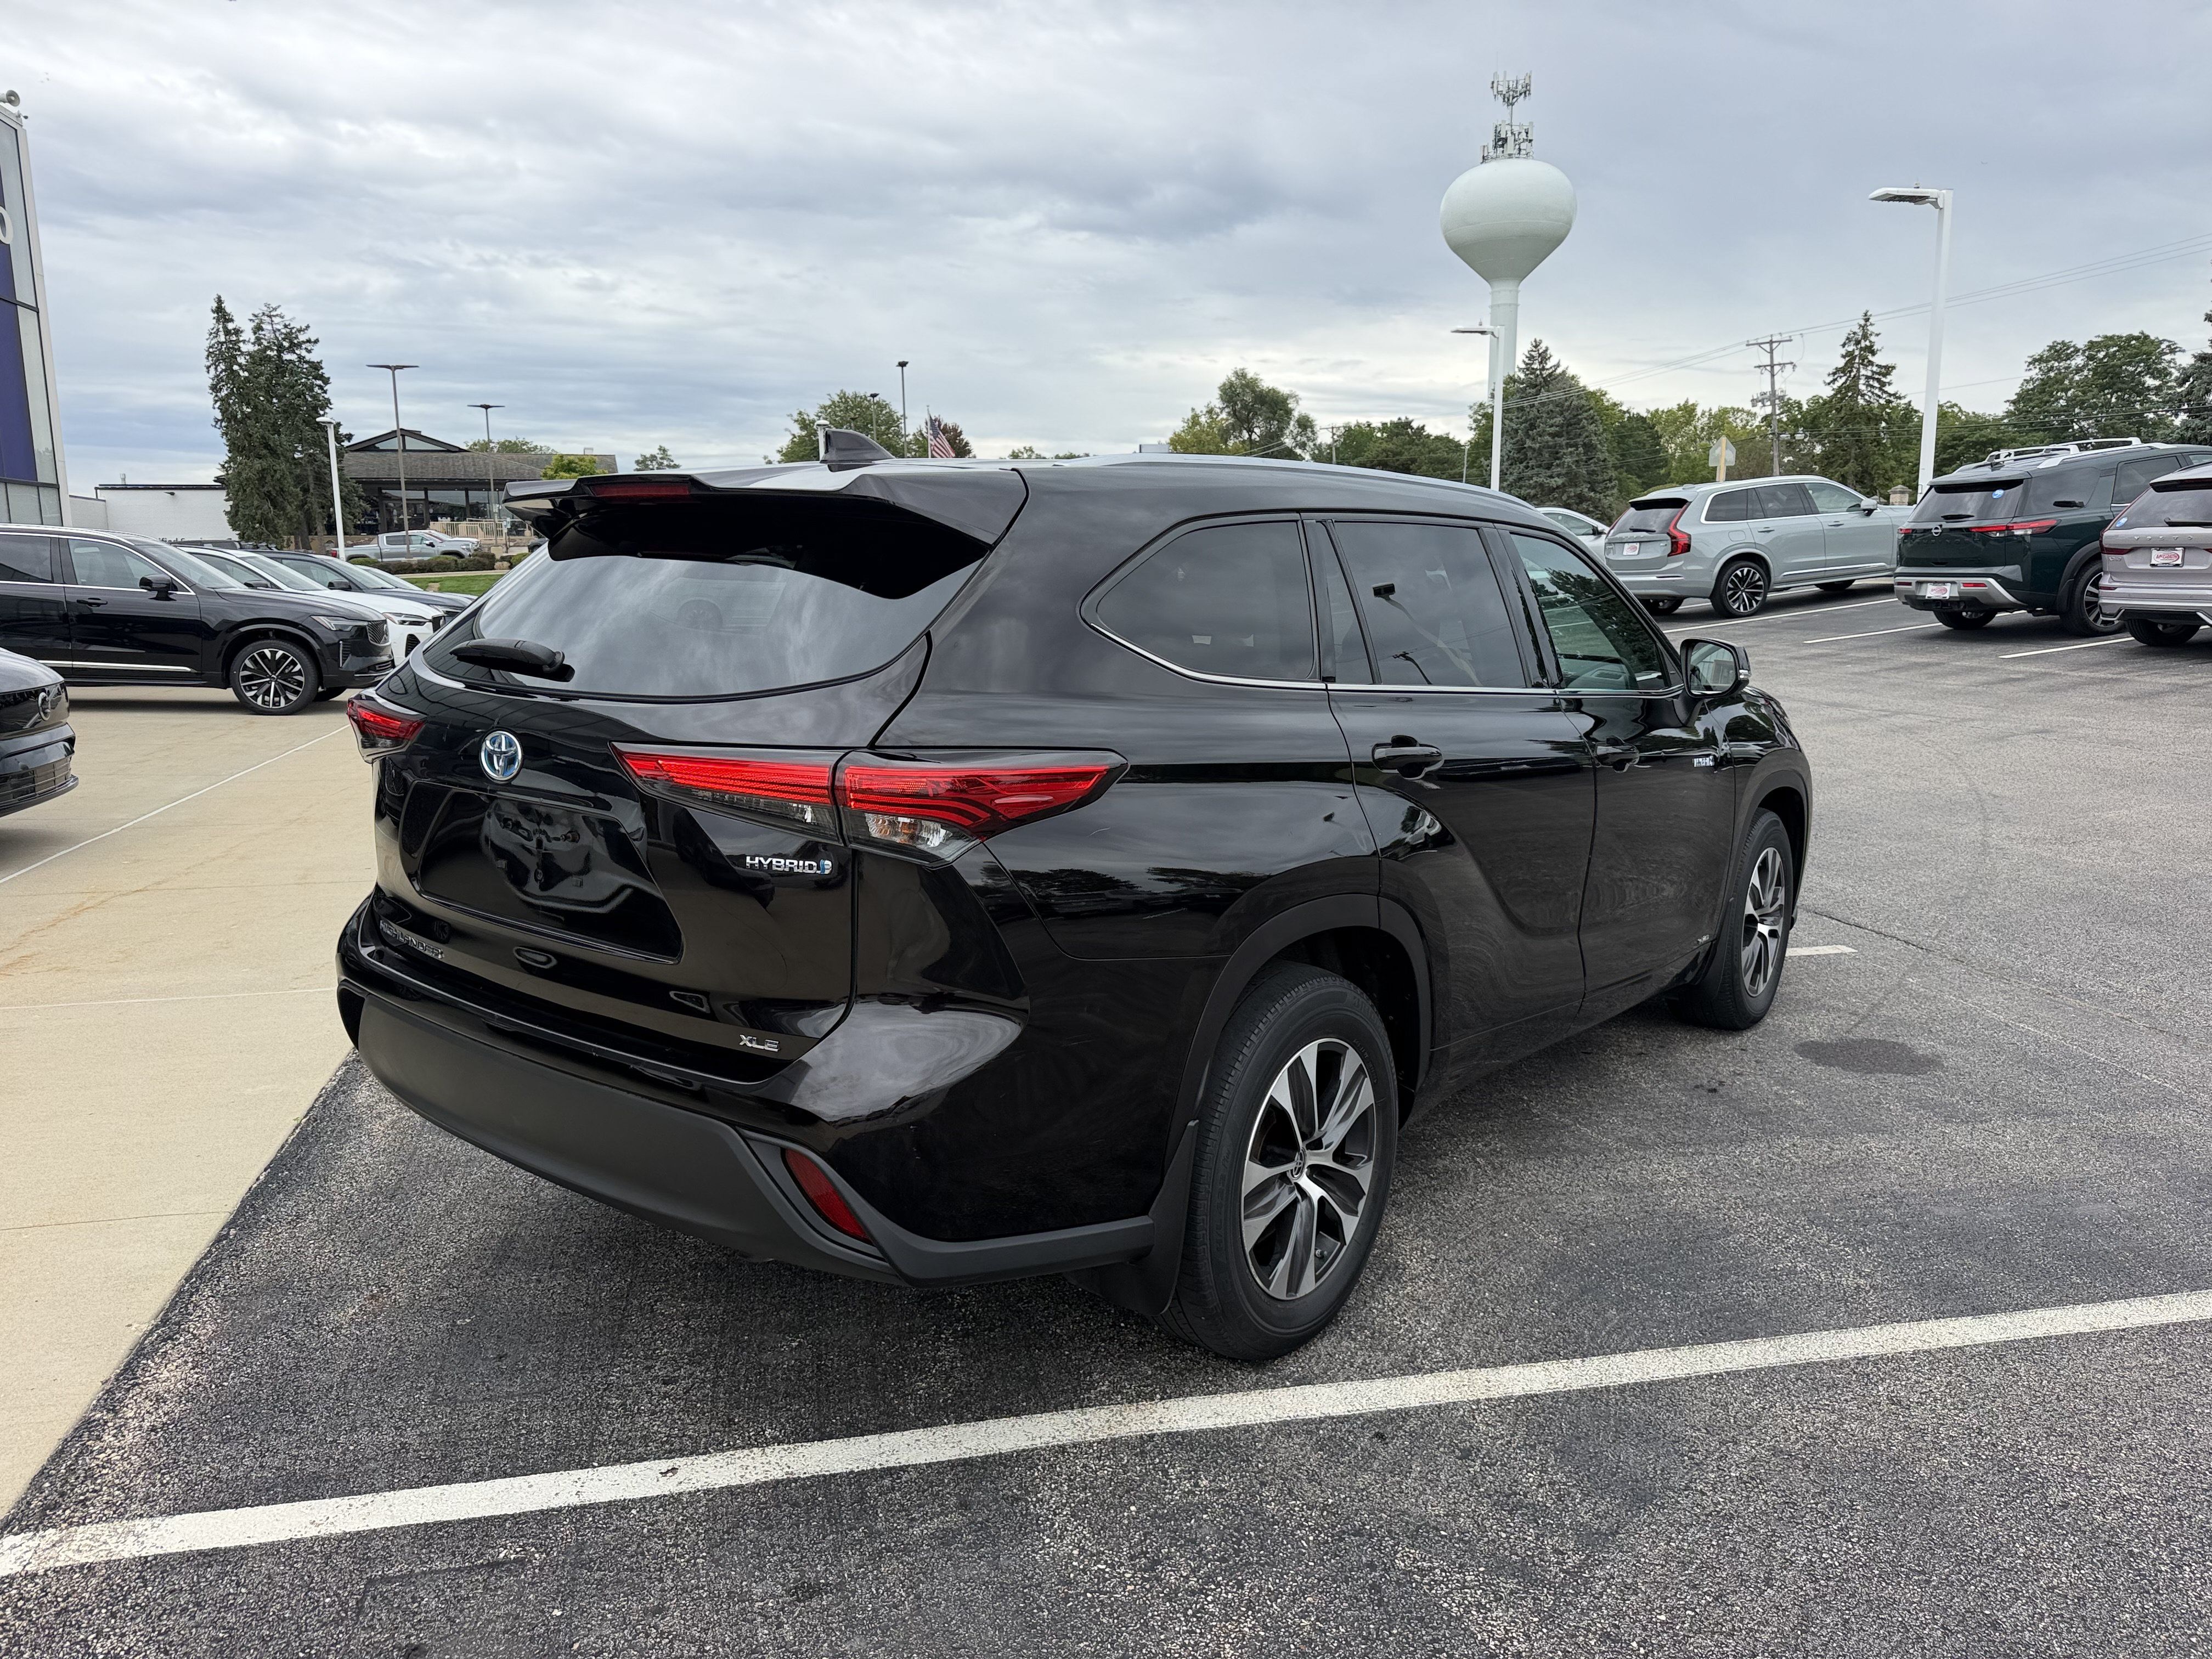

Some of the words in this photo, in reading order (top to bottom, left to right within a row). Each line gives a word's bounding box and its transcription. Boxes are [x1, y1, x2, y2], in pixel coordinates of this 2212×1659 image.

[746, 856, 817, 874] HYBRID
[380, 920, 444, 958] HIGHLANDER
[739, 1034, 779, 1052] XLE
